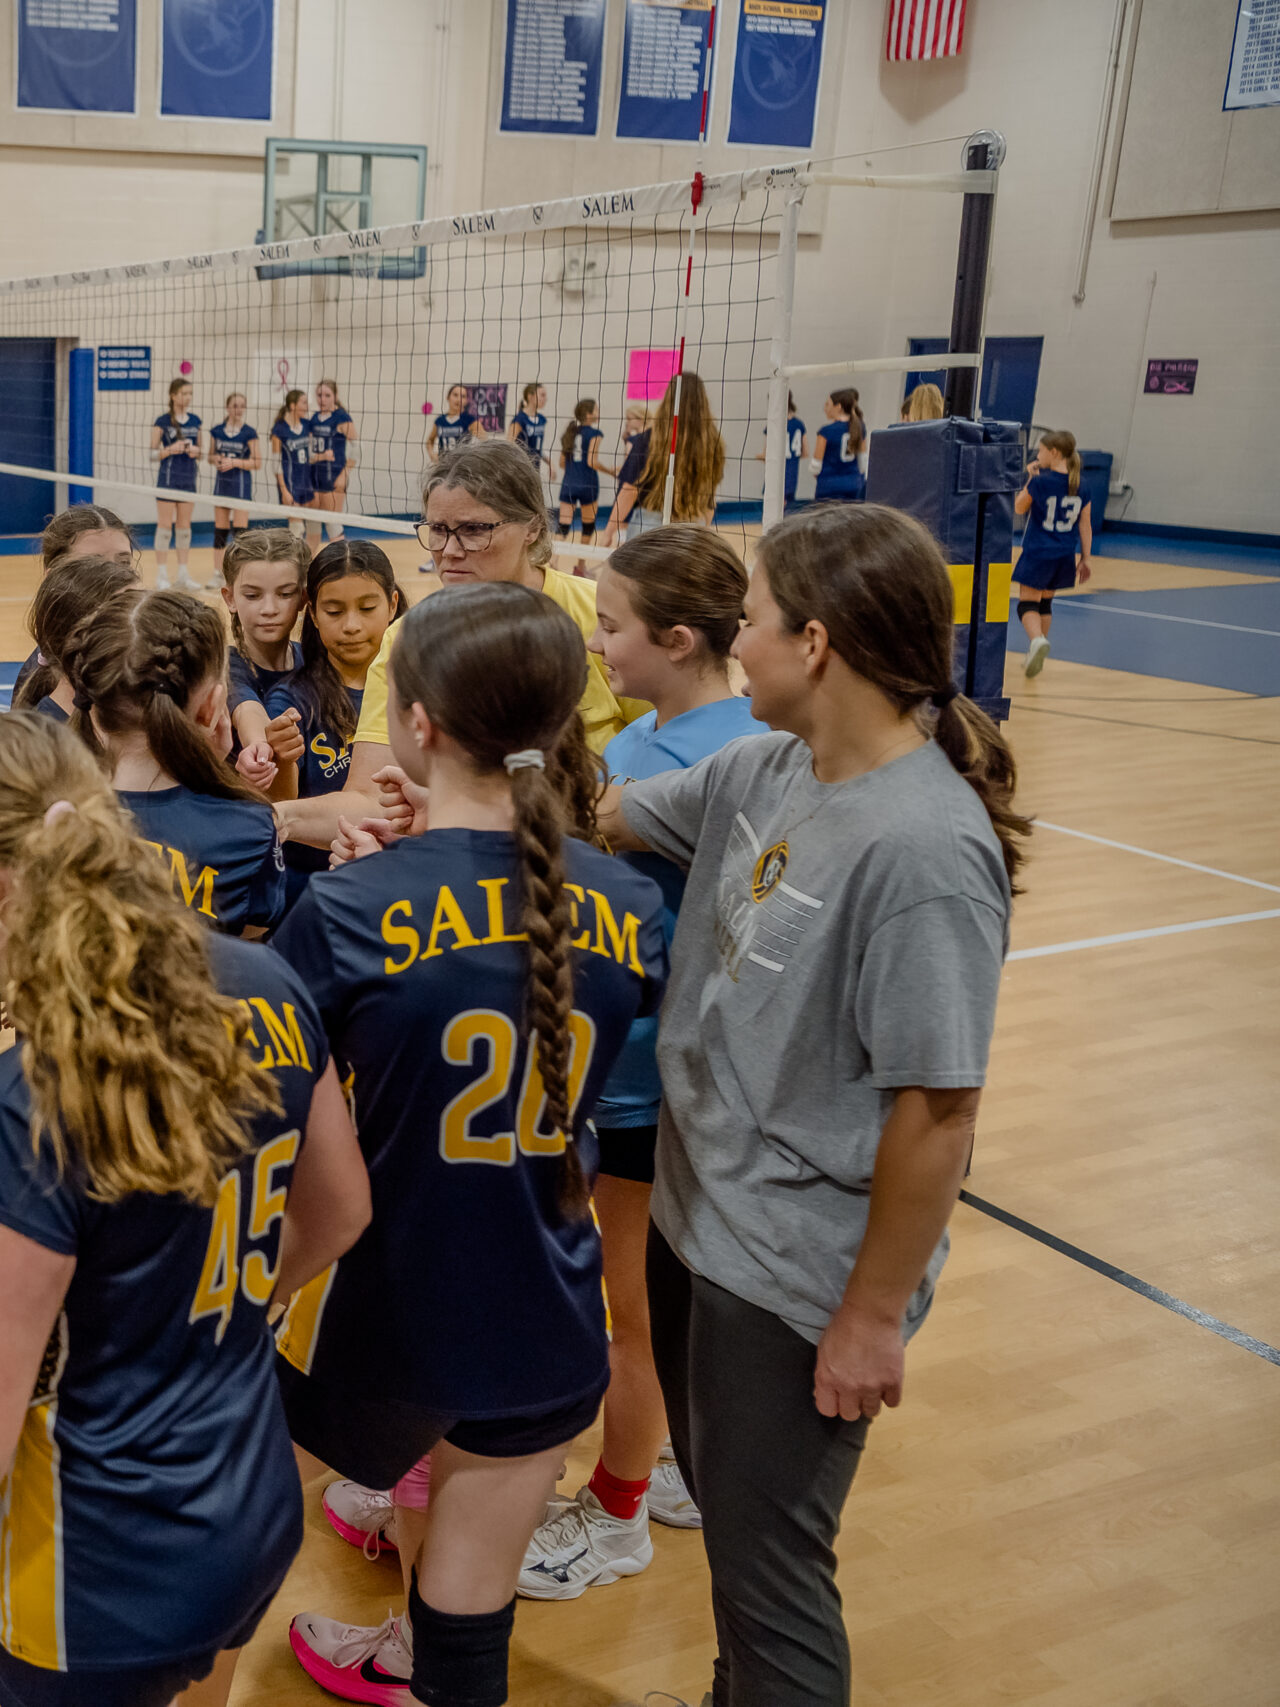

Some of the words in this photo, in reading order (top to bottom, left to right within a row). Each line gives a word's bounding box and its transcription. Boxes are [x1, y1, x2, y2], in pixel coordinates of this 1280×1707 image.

[582, 193, 635, 219] SALEM
[453, 215, 496, 236] SALEM
[260, 245, 289, 261] SALEM
[348, 231, 381, 249] SALEM
[1042, 495, 1082, 532] 13
[439, 1008, 597, 1167] 20
[188, 1129, 301, 1345] 45
